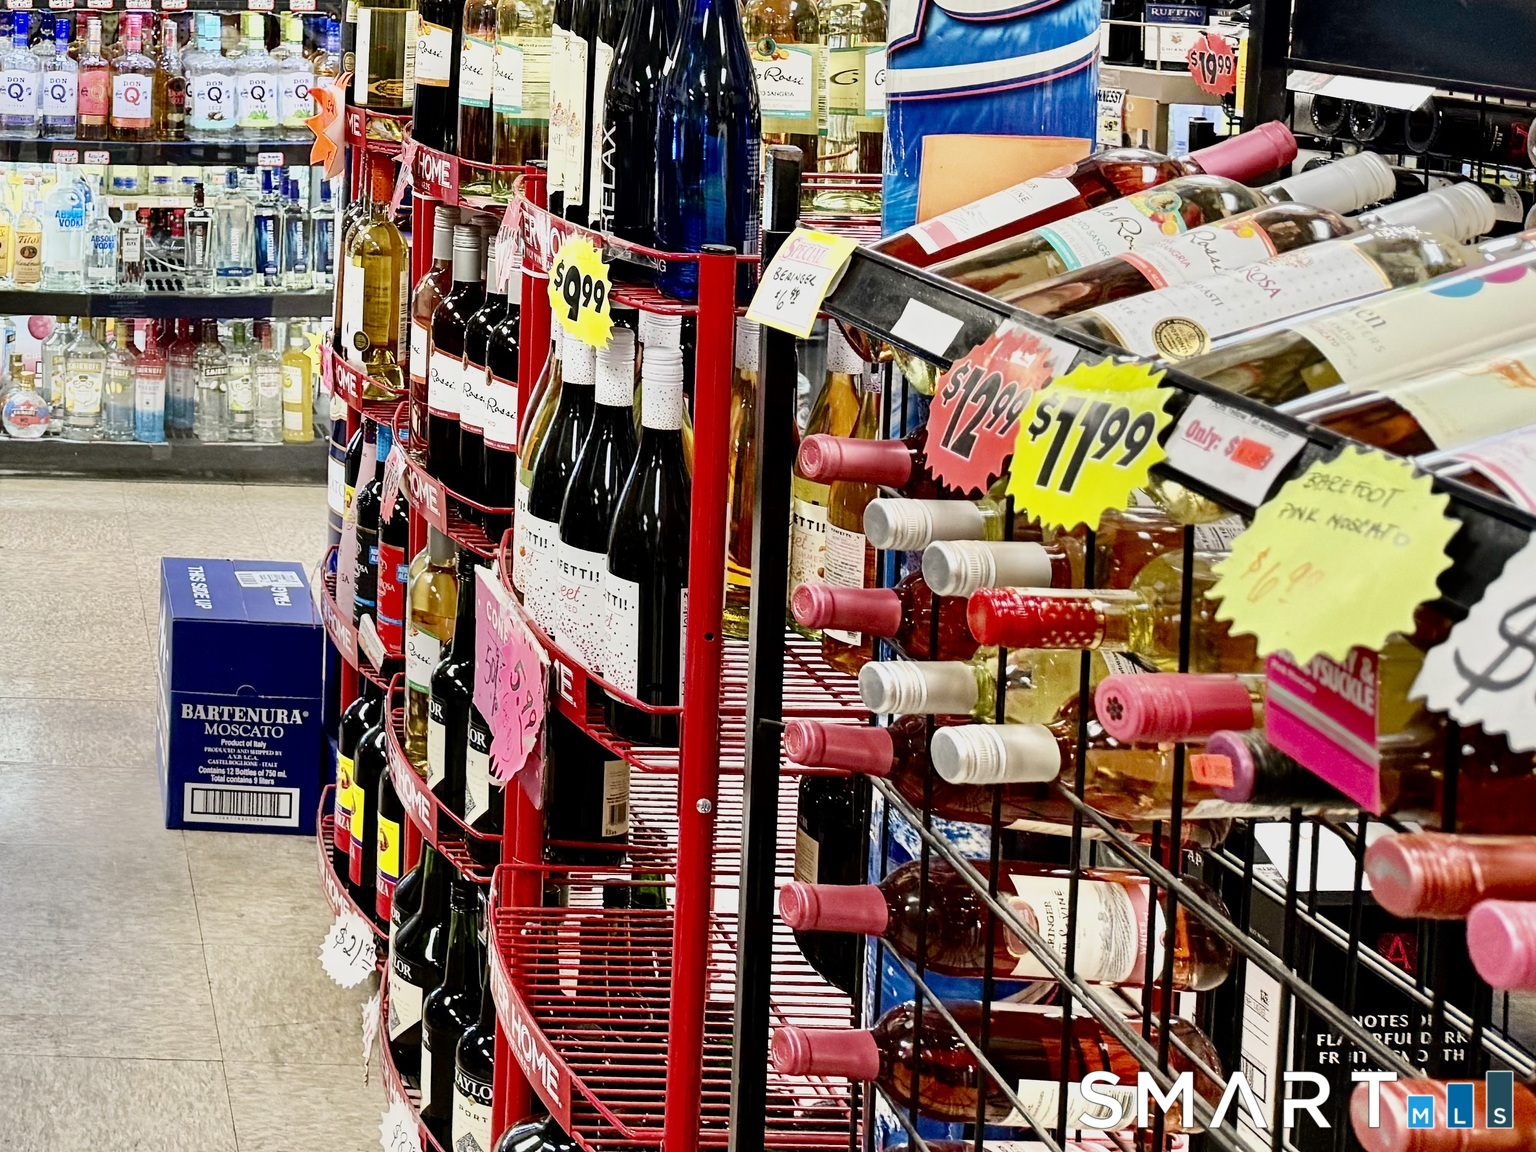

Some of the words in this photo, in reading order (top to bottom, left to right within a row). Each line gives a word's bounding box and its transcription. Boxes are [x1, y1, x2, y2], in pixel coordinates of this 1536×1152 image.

[1151, 7, 1203, 19] RUFFINO
[8, 83, 25, 102] Q
[50, 84, 66, 103] Q
[124, 87, 140, 105] Q
[207, 86, 223, 104] Q
[250, 85, 266, 103] Q
[91, 234, 117, 243] ABSOLUT
[779, 237, 828, 265] SPECIAL
[1238, 261, 1281, 299] ROSA
[431, 367, 456, 391] Rossi
[487, 397, 517, 420] Rossi
[1302, 471, 1408, 509] BAREFOOT
[1276, 501, 1319, 524] PINK
[204, 722, 284, 738] MOSCATO
[220, 738, 243, 748] Product
[253, 740, 267, 749] Italy
[198, 766, 225, 775] Contains
[234, 767, 256, 776] Bottles
[265, 769, 277, 777] 750
[210, 774, 224, 783] Total
[225, 775, 253, 784] contains
[1352, 1015, 1409, 1029] NOTES
[1317, 1032, 1412, 1046] FLRFU
